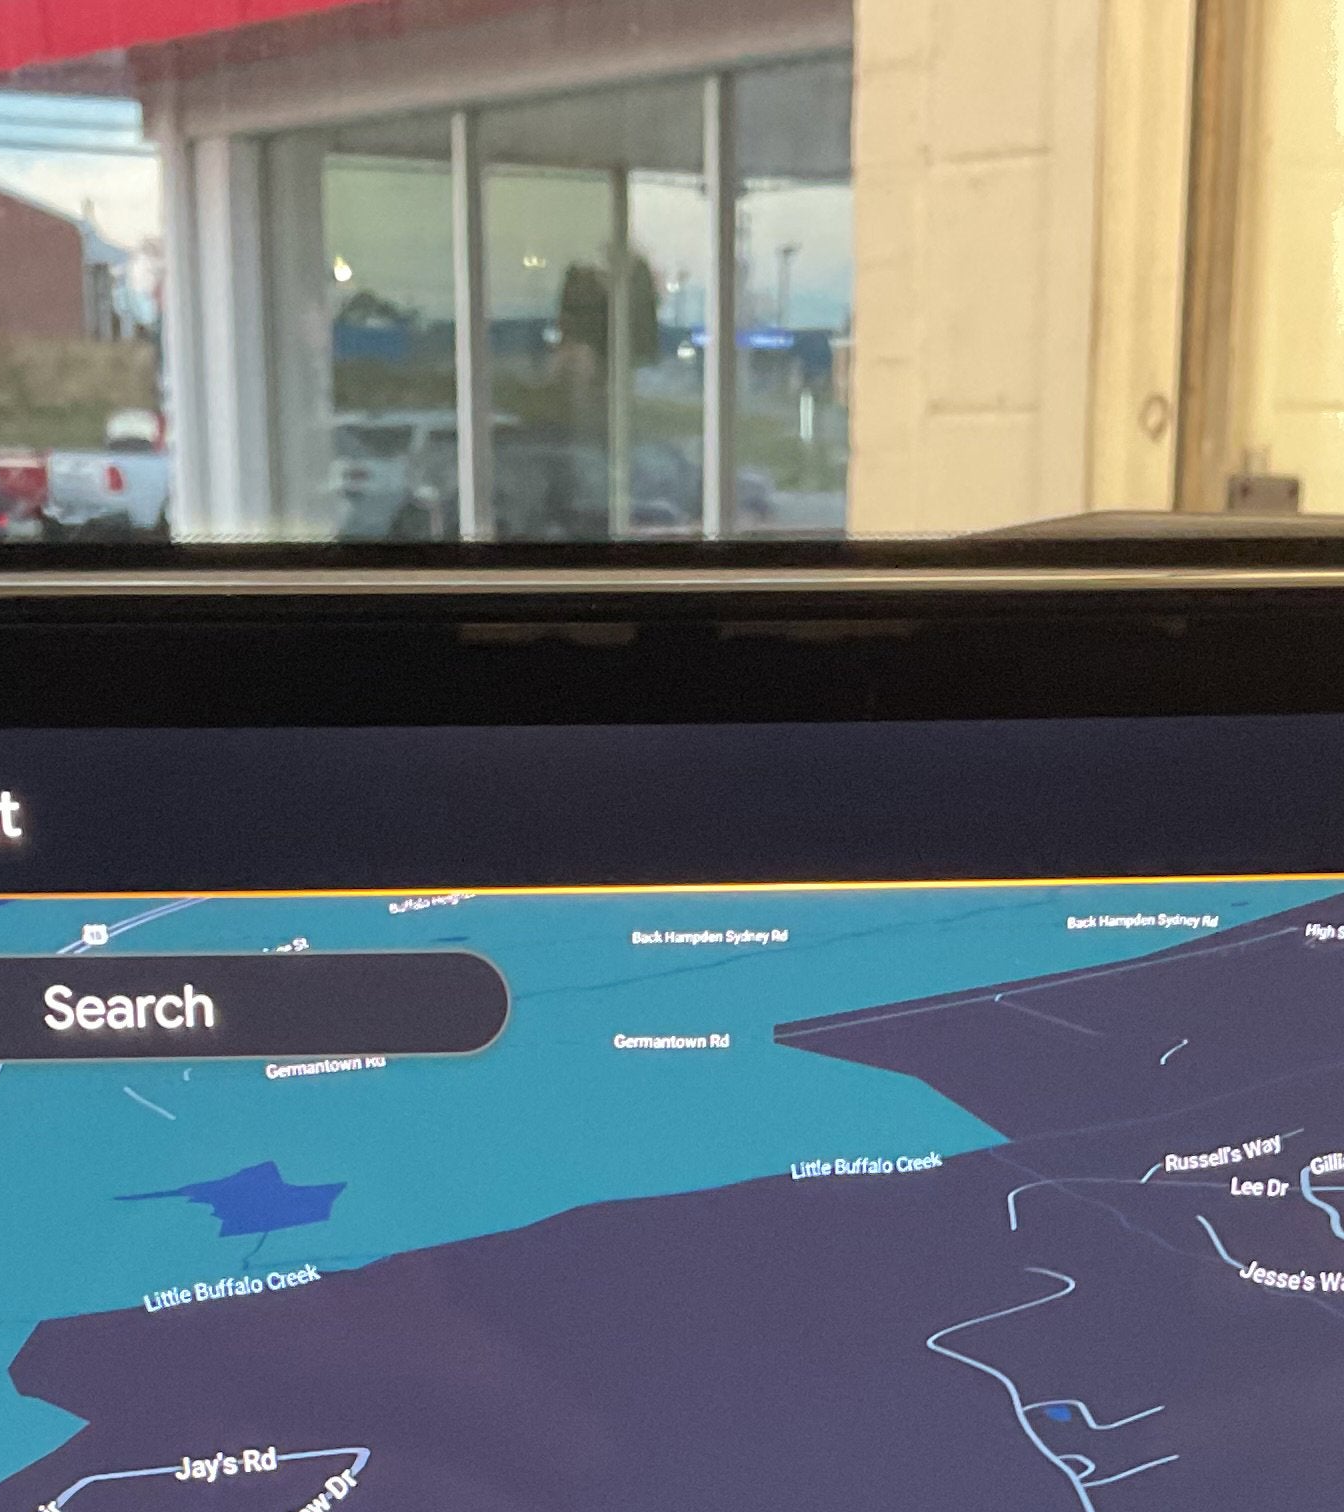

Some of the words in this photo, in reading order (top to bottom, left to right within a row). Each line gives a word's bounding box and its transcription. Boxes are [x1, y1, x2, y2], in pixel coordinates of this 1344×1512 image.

[1067, 915, 1097, 928] Back
[1099, 915, 1155, 929] Hampden
[1157, 913, 1200, 928] Sydney
[1202, 915, 1218, 927] Rd
[1305, 923, 1335, 940] High
[631, 931, 662, 944] Back
[665, 931, 723, 945] Hampden
[726, 930, 769, 945] Sydney
[771, 929, 788, 942] Rd
[44, 983, 214, 1032] Search
[614, 1034, 706, 1050] Germantown
[709, 1034, 729, 1048] Rd
[265, 1057, 362, 1080] Germantown
[791, 1158, 831, 1181] Little
[834, 1156, 893, 1176] Buffalo
[896, 1151, 943, 1173] Creek
[1165, 1146, 1241, 1173] Russell's
[1243, 1134, 1281, 1163] Way
[1230, 1177, 1264, 1196] Lee
[1268, 1179, 1289, 1197] Dr
[143, 1284, 191, 1314] Little
[195, 1275, 263, 1303] Buffalo
[266, 1264, 321, 1291] Creek
[1239, 1260, 1316, 1291] Jesse's
[176, 1453, 238, 1484] Jay's
[243, 1447, 276, 1471] Rd
[325, 1468, 358, 1501] Dr
